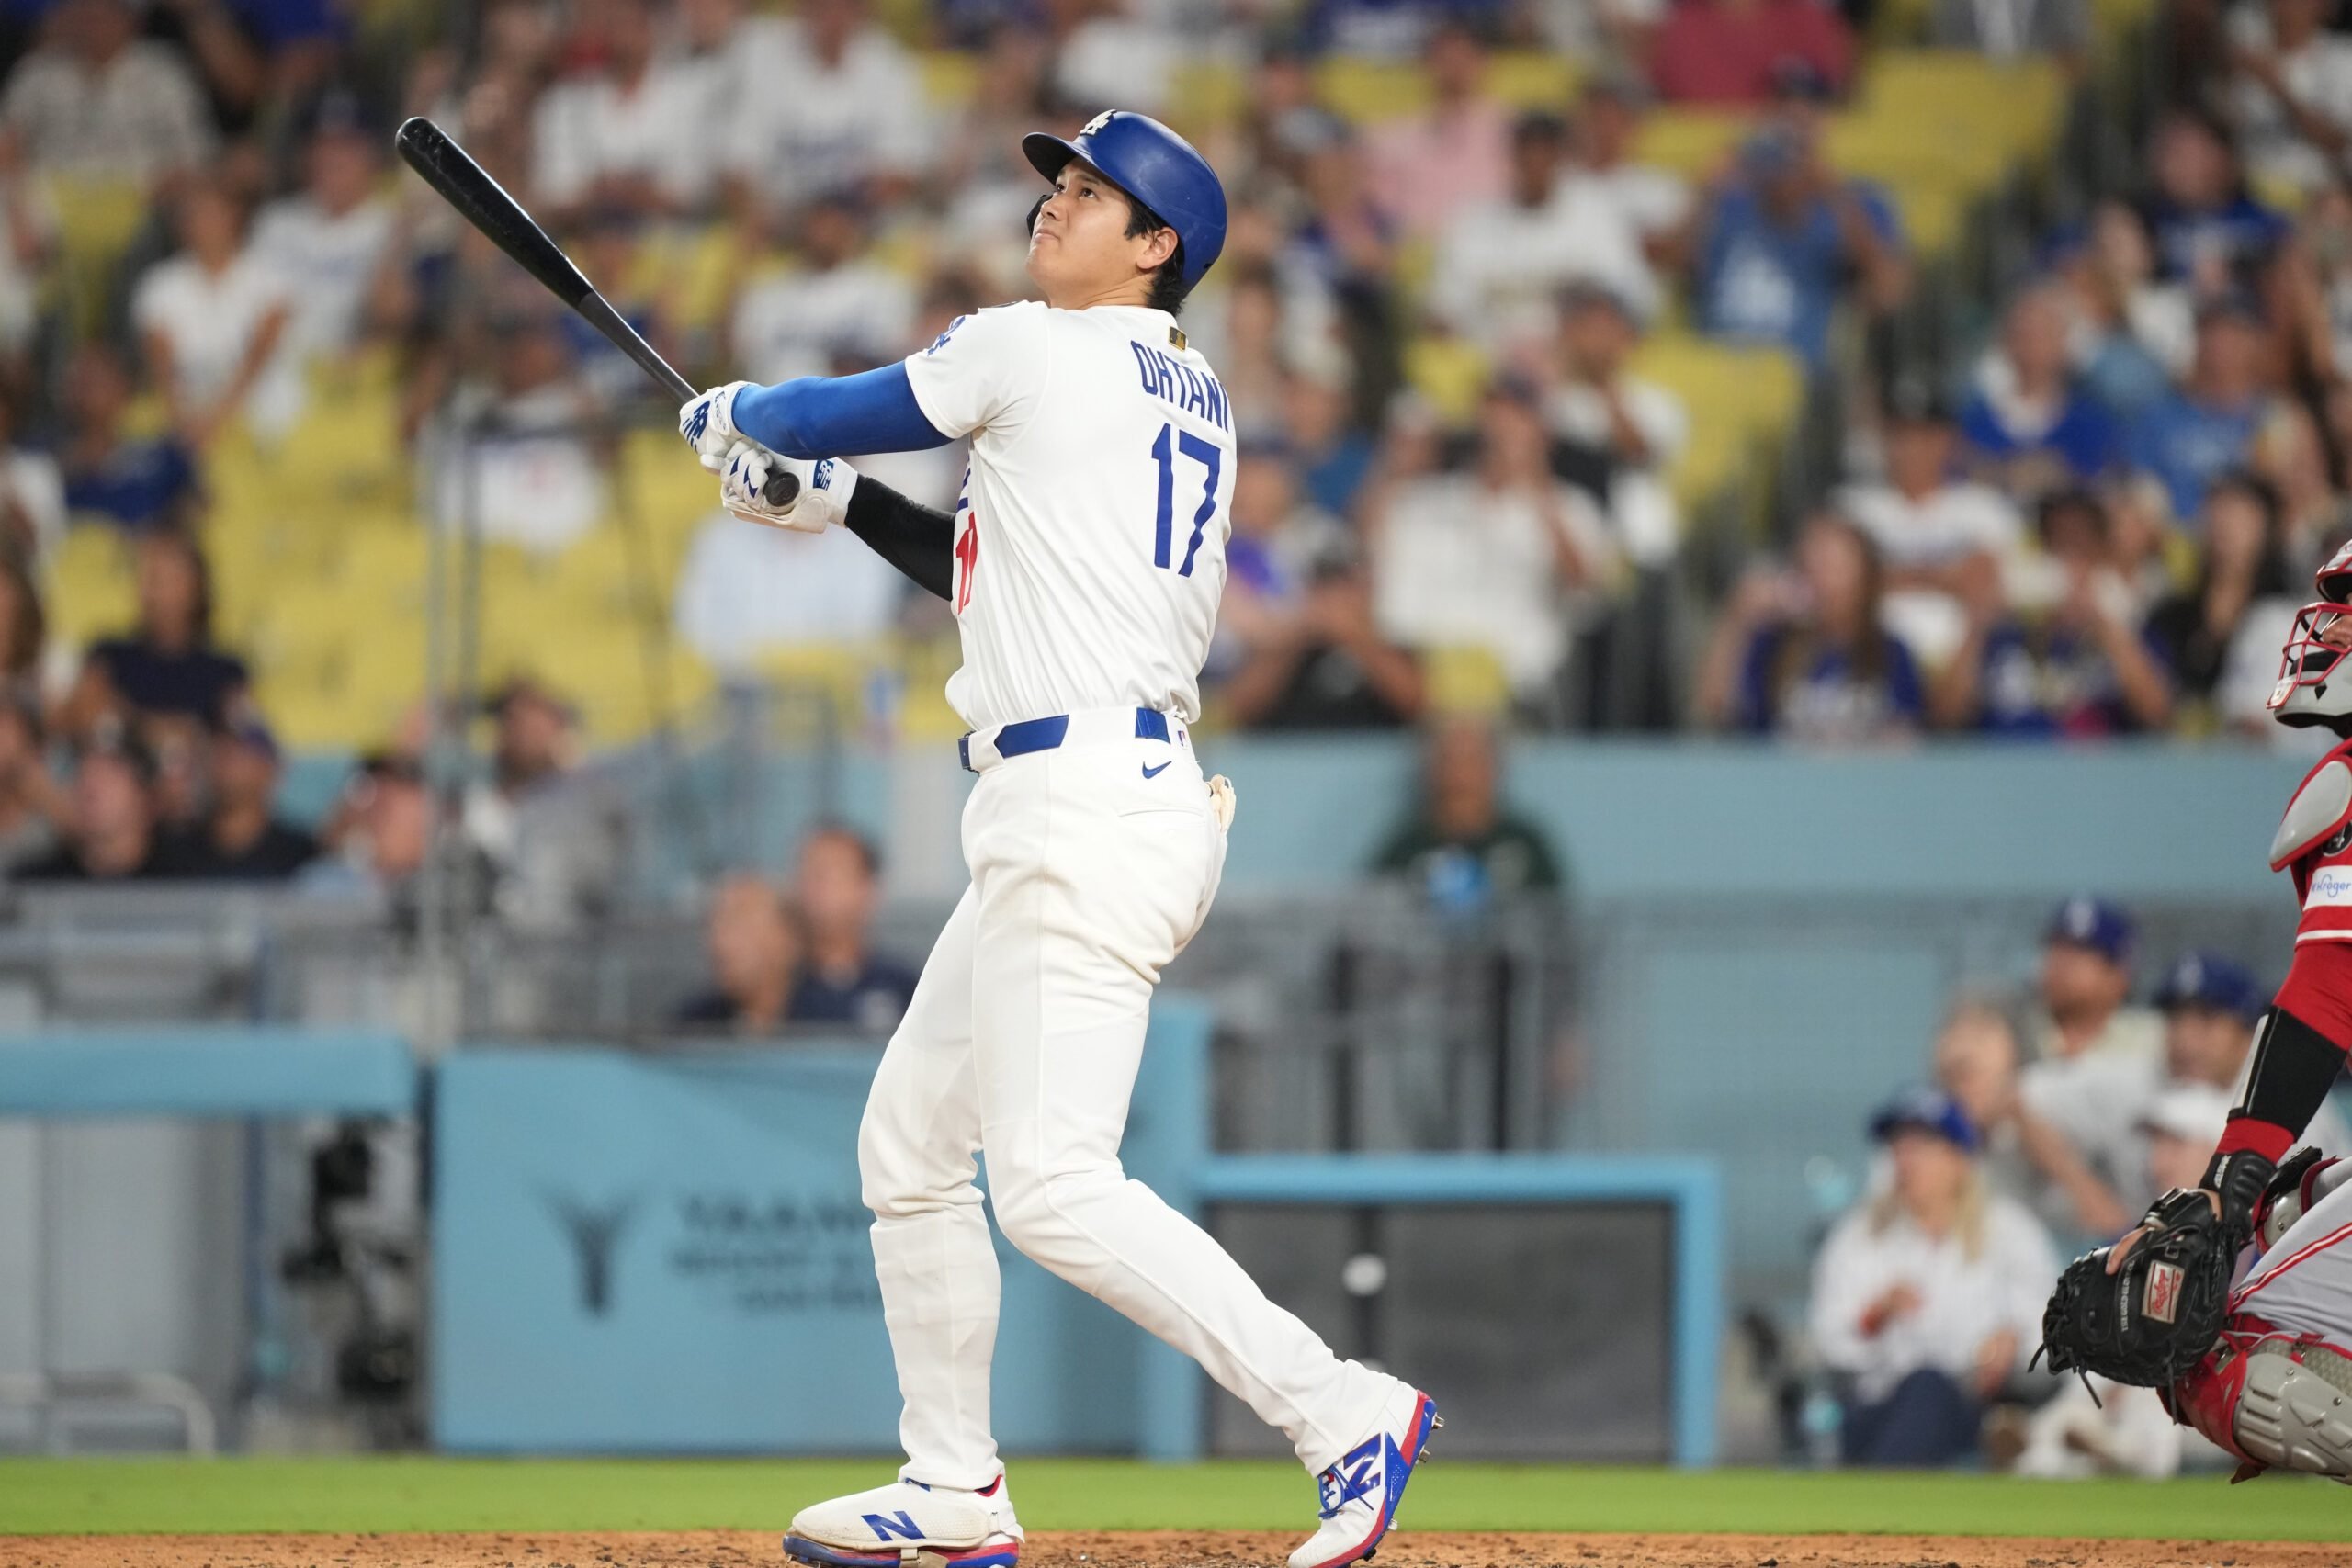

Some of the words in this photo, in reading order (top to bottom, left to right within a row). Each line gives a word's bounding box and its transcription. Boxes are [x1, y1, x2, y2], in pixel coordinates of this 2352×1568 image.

[1130, 340, 1229, 434] OHTANI
[1151, 423, 1222, 578] 17
[860, 1511, 927, 1542] N
